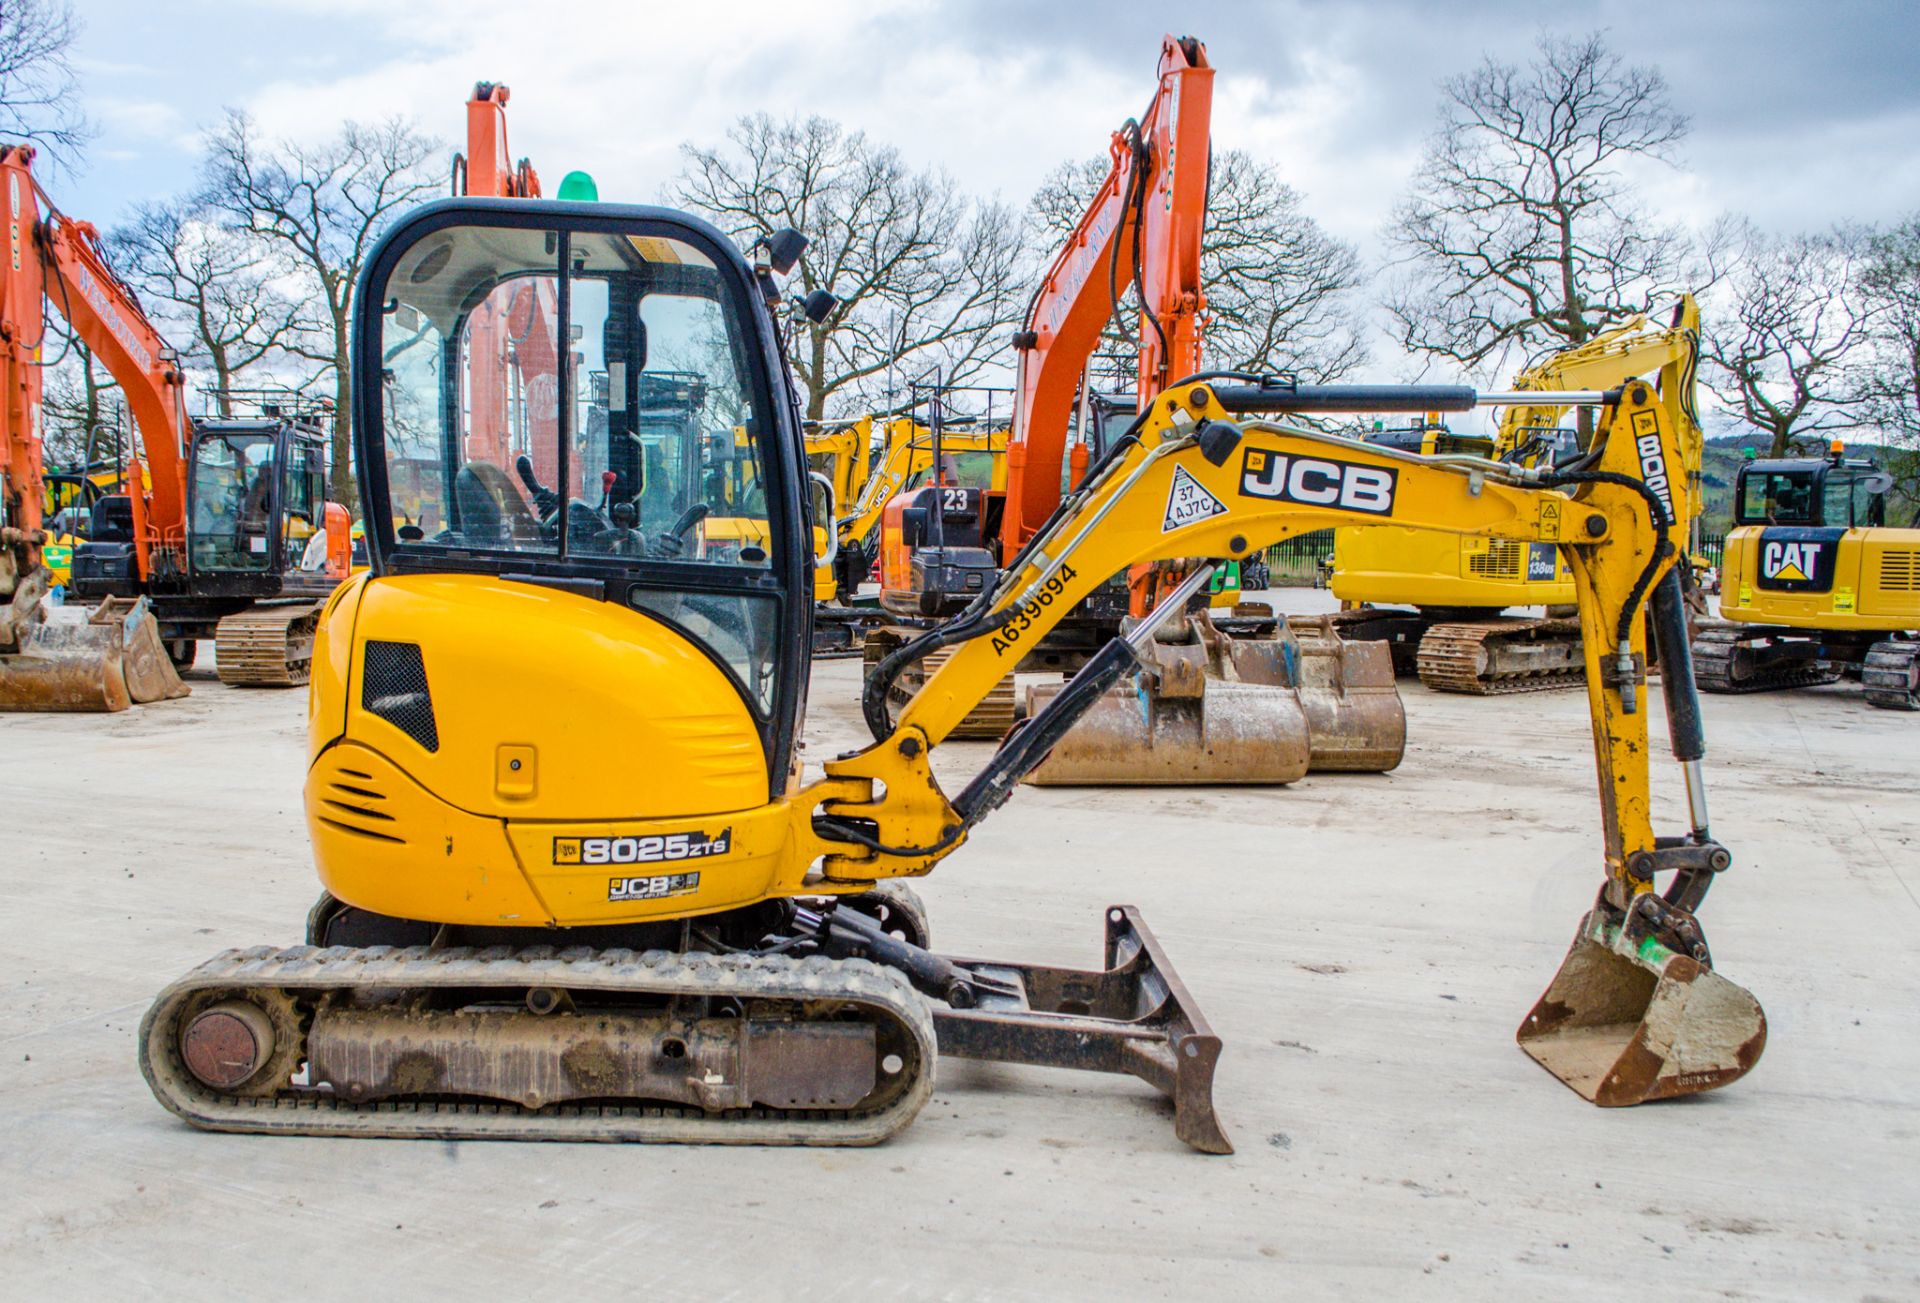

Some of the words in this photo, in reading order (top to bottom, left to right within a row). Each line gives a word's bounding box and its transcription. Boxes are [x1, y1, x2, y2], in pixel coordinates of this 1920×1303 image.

[1178, 484, 1194, 501] 37
[1244, 455, 1393, 512] JCB
[873, 484, 890, 508] JCB
[943, 489, 968, 511] 23
[1176, 498, 1211, 519] AJ7C
[1763, 541, 1821, 580] CAT
[991, 563, 1077, 657] A639694
[610, 876, 669, 895] JCB
